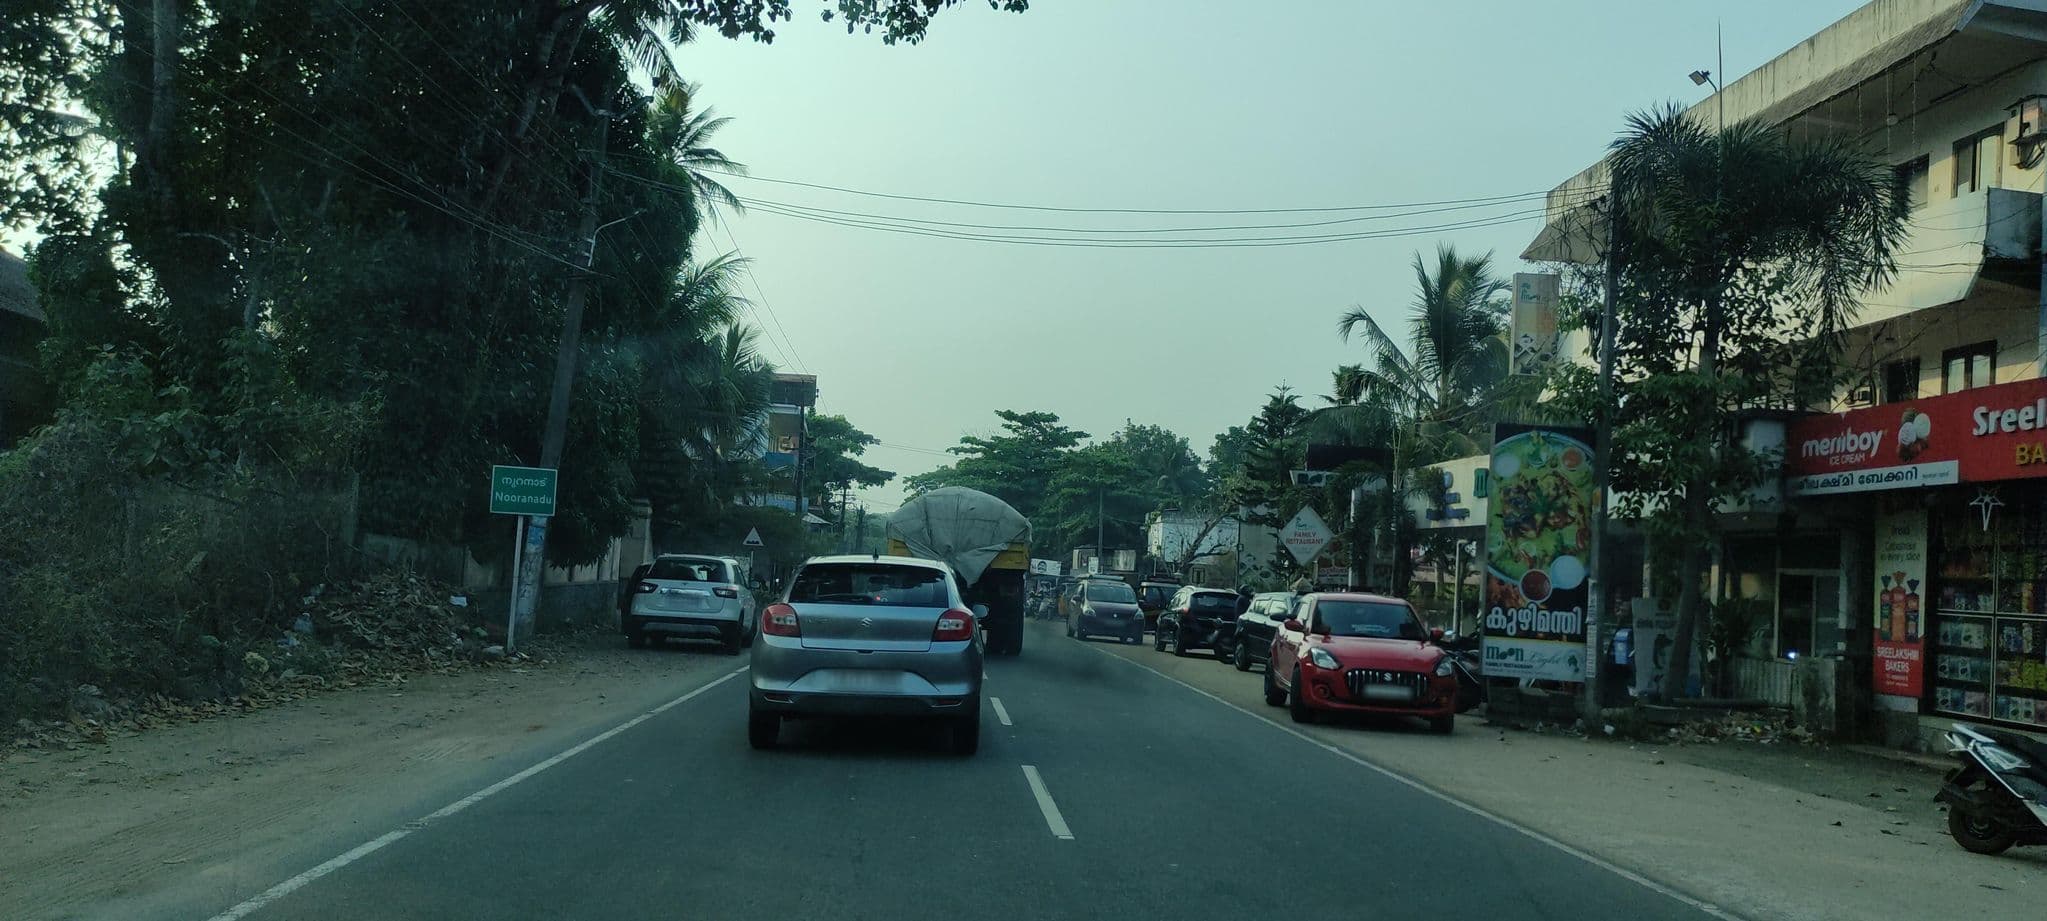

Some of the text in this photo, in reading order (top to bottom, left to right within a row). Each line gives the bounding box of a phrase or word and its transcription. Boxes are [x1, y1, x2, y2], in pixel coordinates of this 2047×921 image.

[1973, 397, 2047, 436] Sreel
[1830, 453, 1865, 465] ICE CREAM
[1858, 466, 1918, 485] ബേക്കറി
[495, 491, 552, 504] Nooranadu
[1486, 603, 1582, 636] കുഴിമന്തി
[1877, 646, 1919, 661] SREELAKSHMI
[1885, 660, 1910, 673] BAKERS
